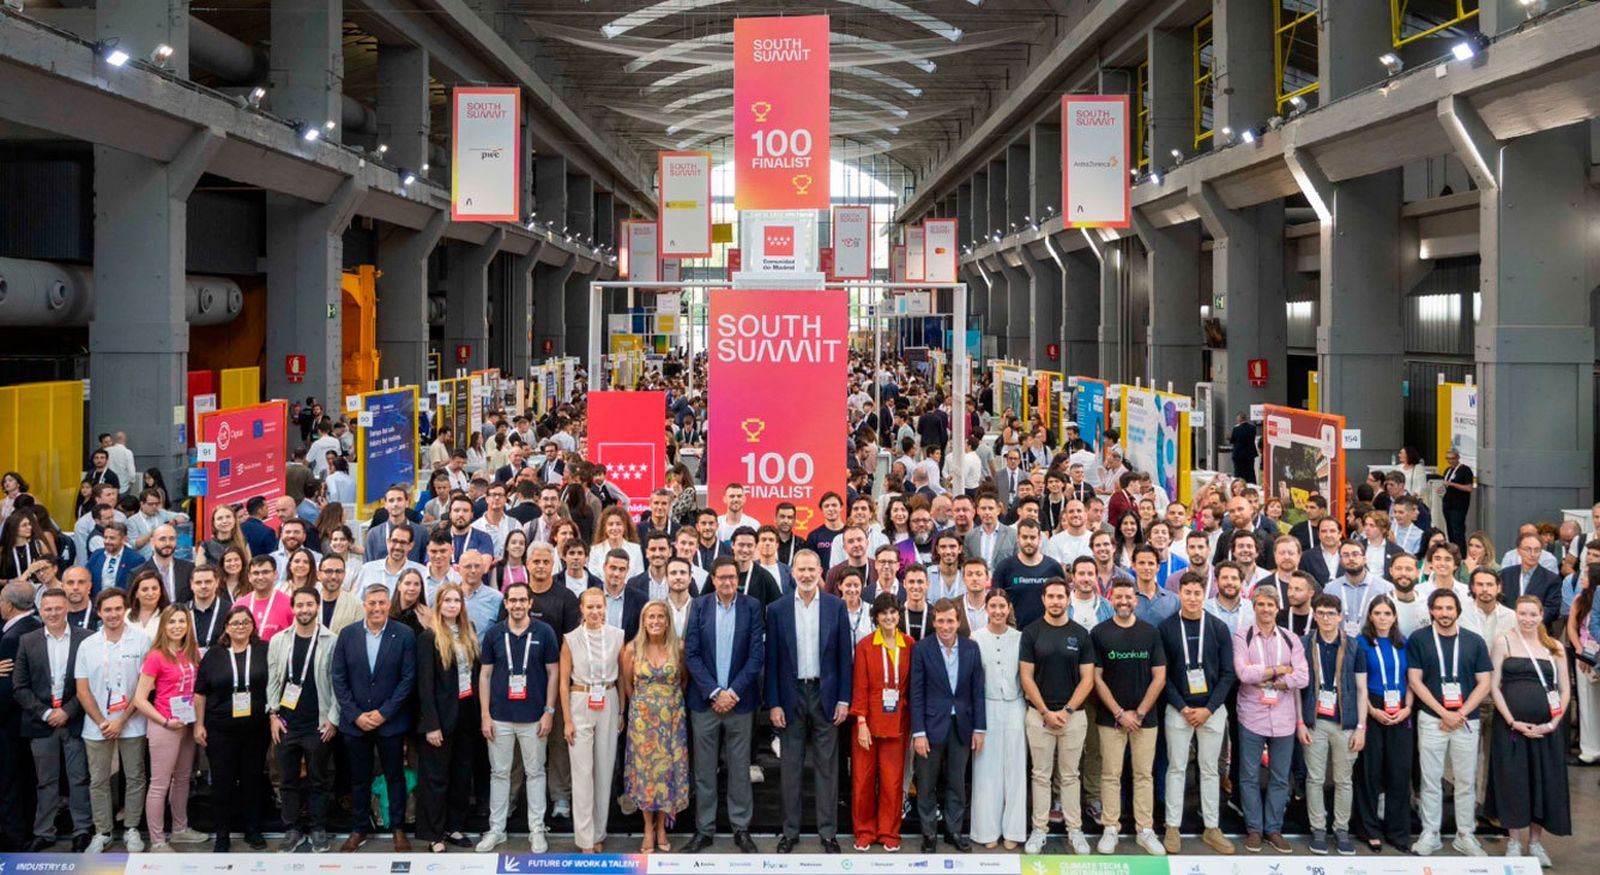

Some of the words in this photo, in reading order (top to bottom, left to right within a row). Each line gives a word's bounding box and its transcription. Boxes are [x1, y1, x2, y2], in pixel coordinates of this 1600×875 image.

[753, 38, 802, 50] SOUTH
[753, 49, 811, 62] SUMMIT
[467, 102, 502, 111] SOUTH
[467, 110, 508, 119] SUMMIT
[1075, 109, 1110, 118] SOUTH
[1075, 117, 1116, 126] SUMMIT
[751, 129, 812, 157] 100
[752, 157, 812, 169] FINALIST
[669, 169, 702, 177] SUMMIT
[717, 313, 821, 338] SOUTH
[717, 338, 842, 363] SUMMIT
[740, 452, 814, 484] 100
[743, 486, 814, 499] FINALIST
[16, 863, 61, 871] INDUSTRY
[528, 859, 560, 867] FUTURE
[561, 859, 573, 867] OF
[574, 859, 600, 868] WORK
[609, 860, 640, 868] TALENT
